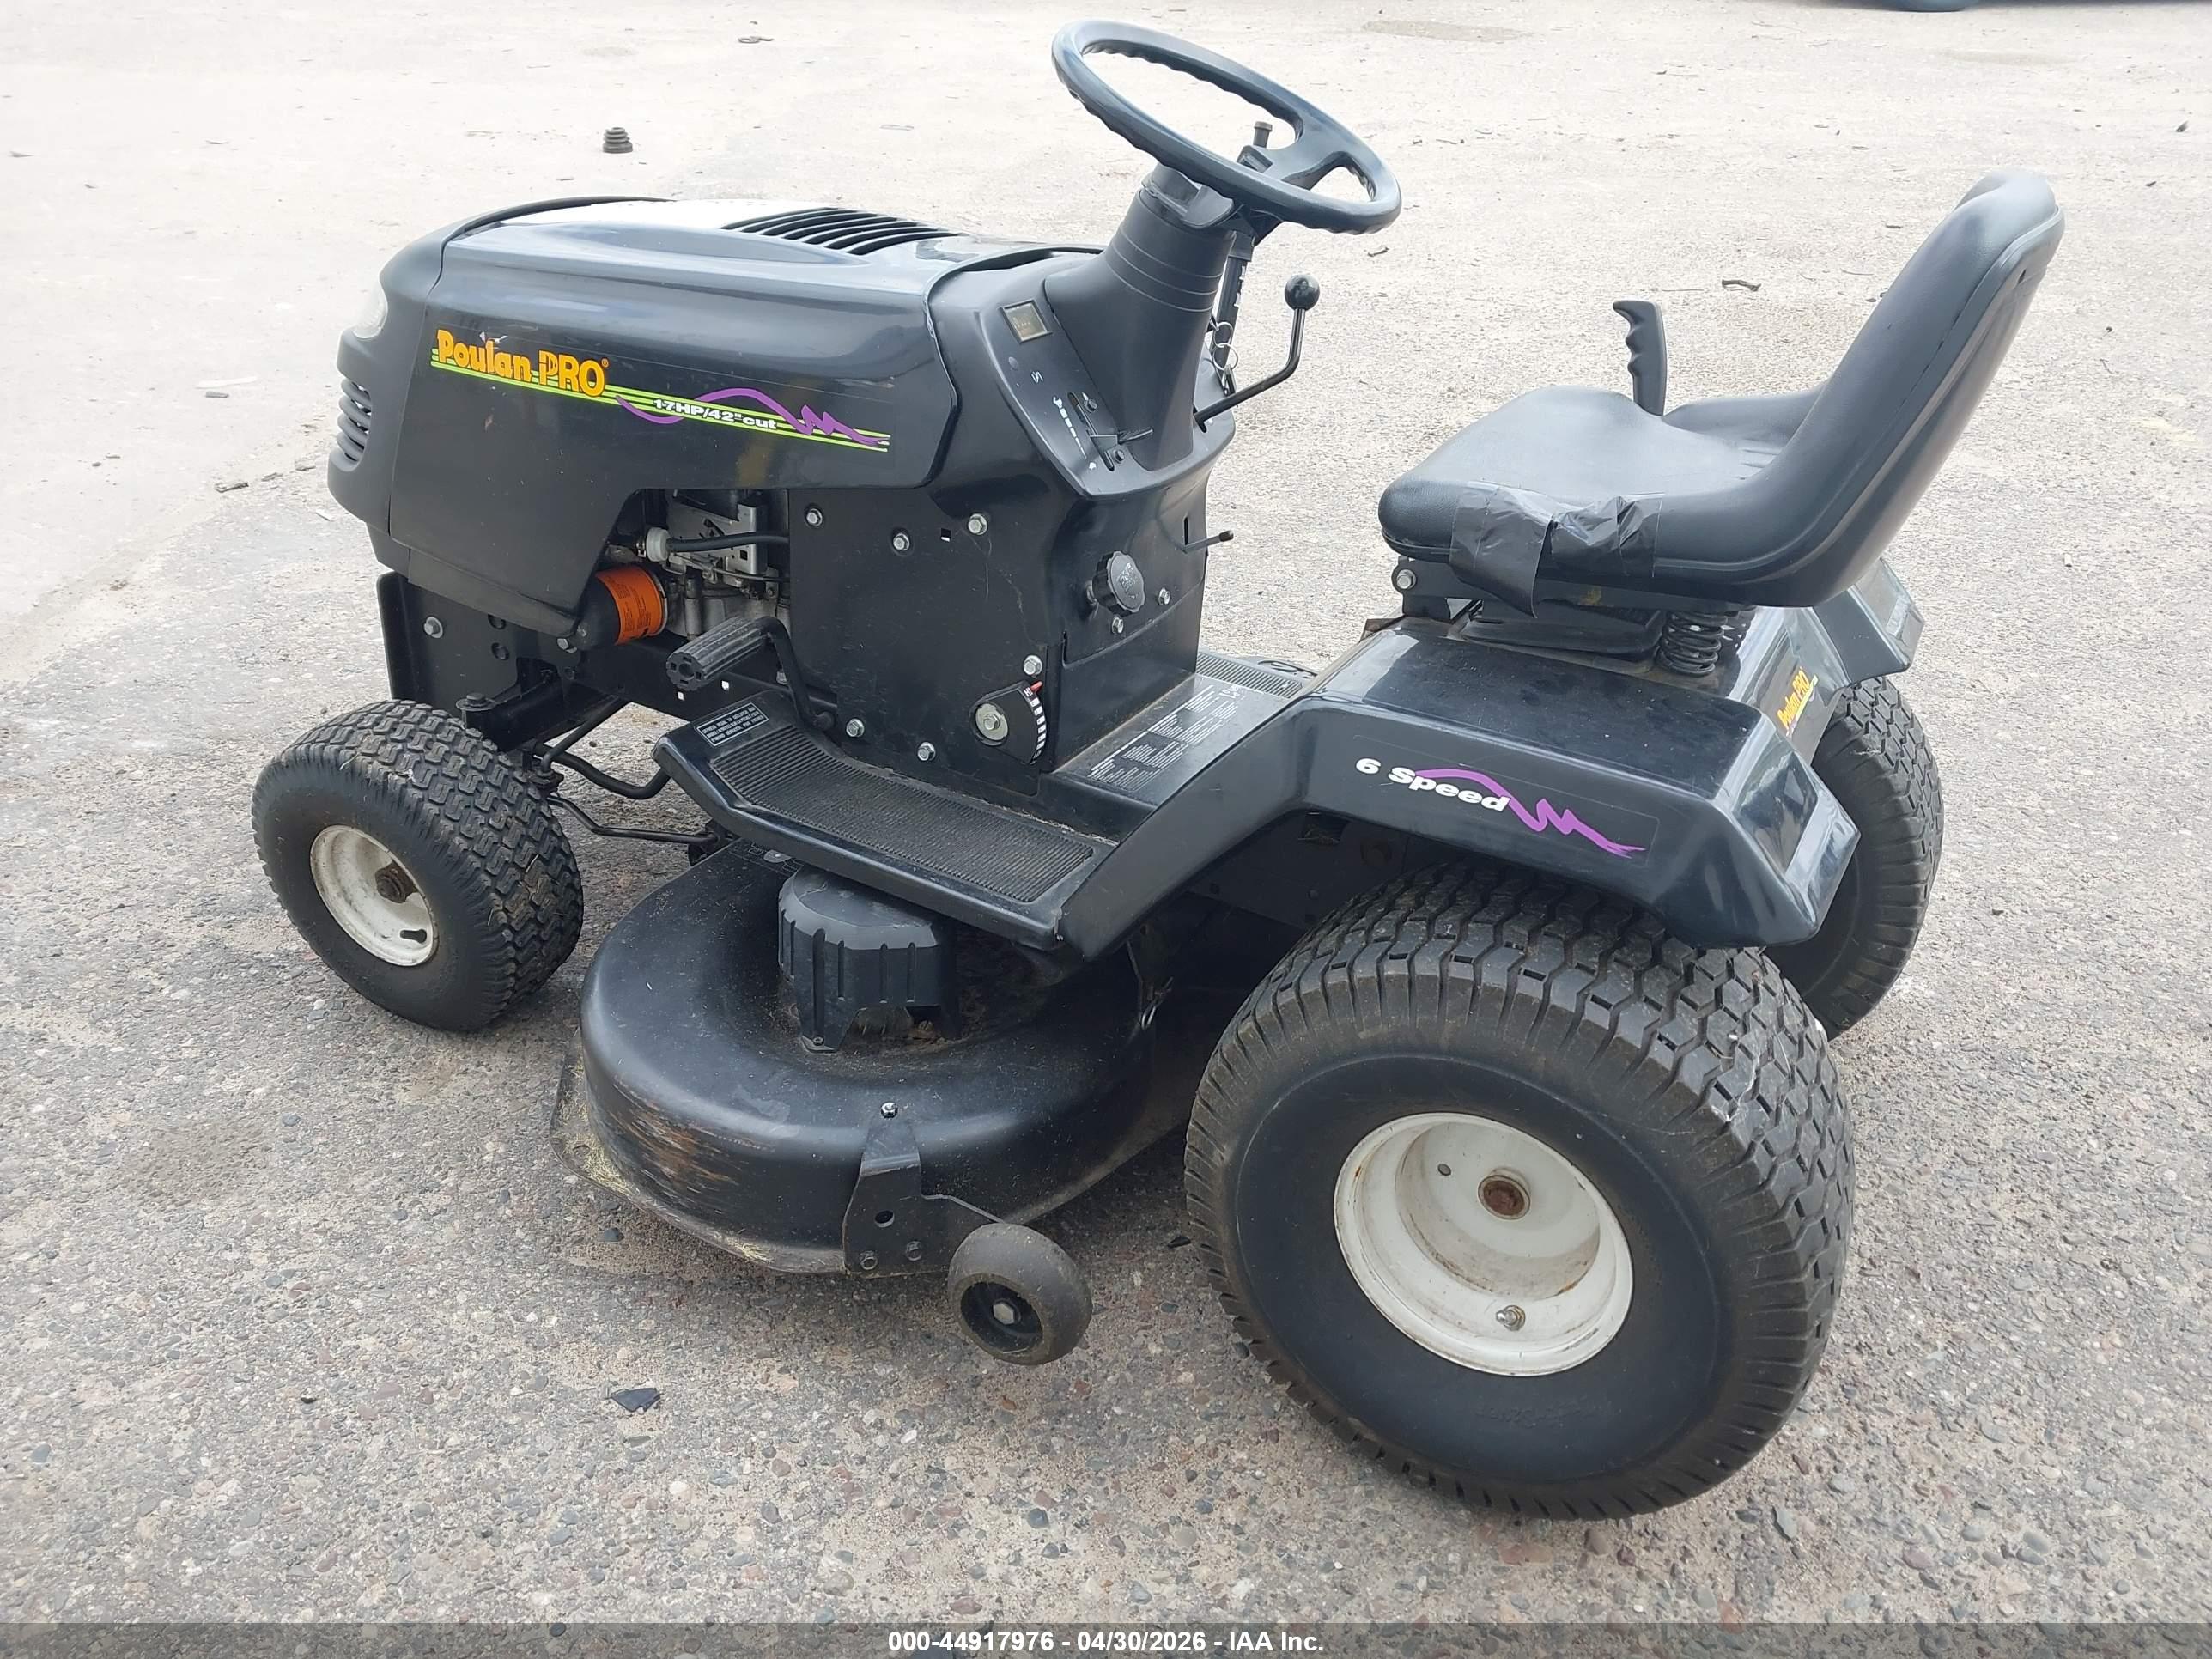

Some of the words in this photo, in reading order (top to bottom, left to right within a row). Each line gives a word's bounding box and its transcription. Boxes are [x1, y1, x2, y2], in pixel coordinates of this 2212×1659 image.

[436, 329, 532, 382] Poulan
[1355, 757, 1382, 775] 6
[1387, 766, 1511, 812] Speed
